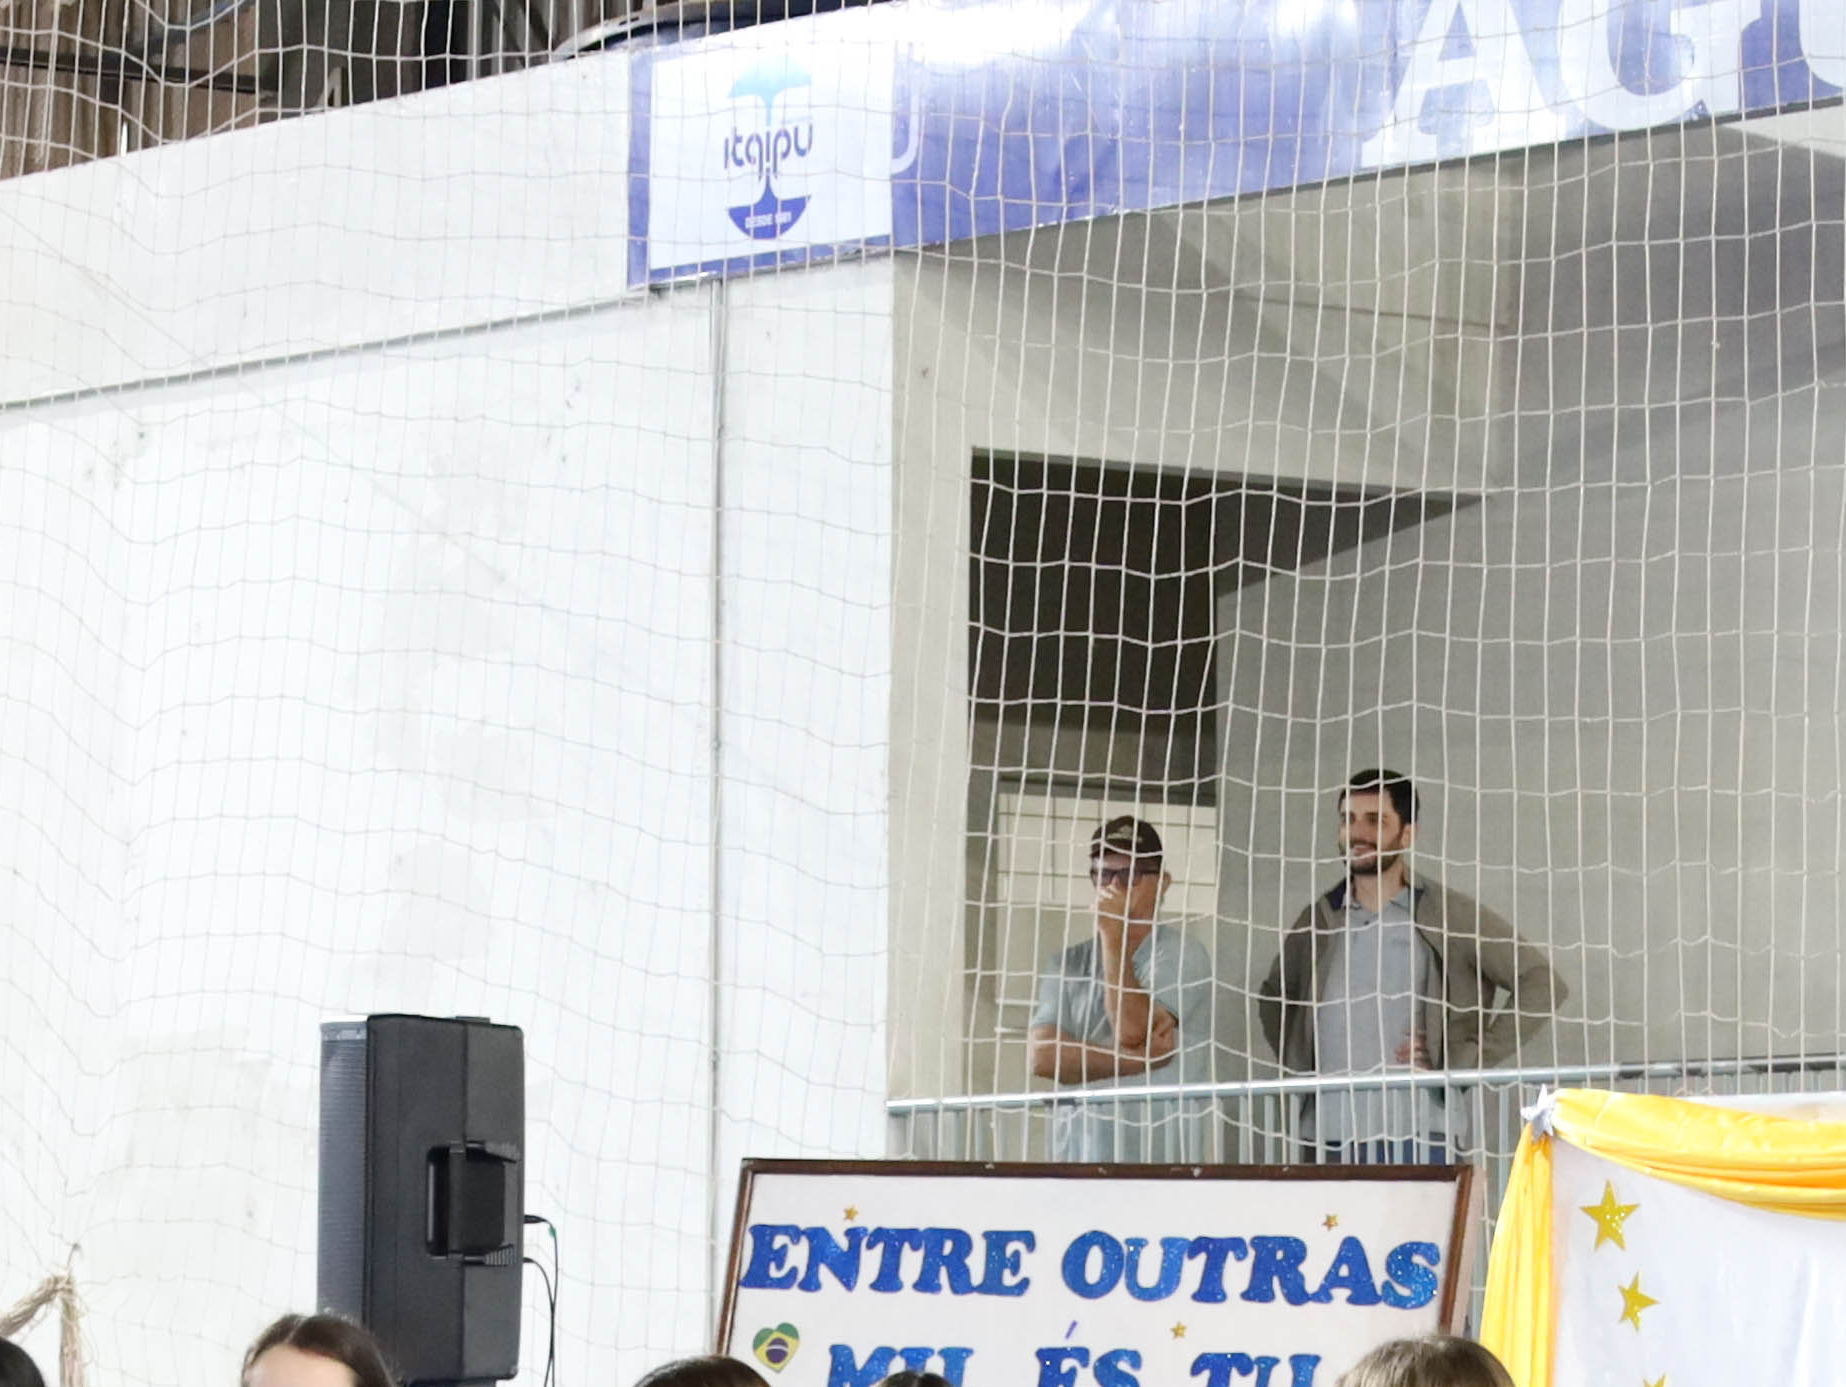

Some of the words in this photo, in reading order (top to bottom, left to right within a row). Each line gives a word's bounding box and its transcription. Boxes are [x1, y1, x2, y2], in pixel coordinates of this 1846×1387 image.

[724, 123, 813, 183] itaipu
[739, 1224, 1036, 1297] ENTRE
[1061, 1230, 1441, 1309] OUTRAS
